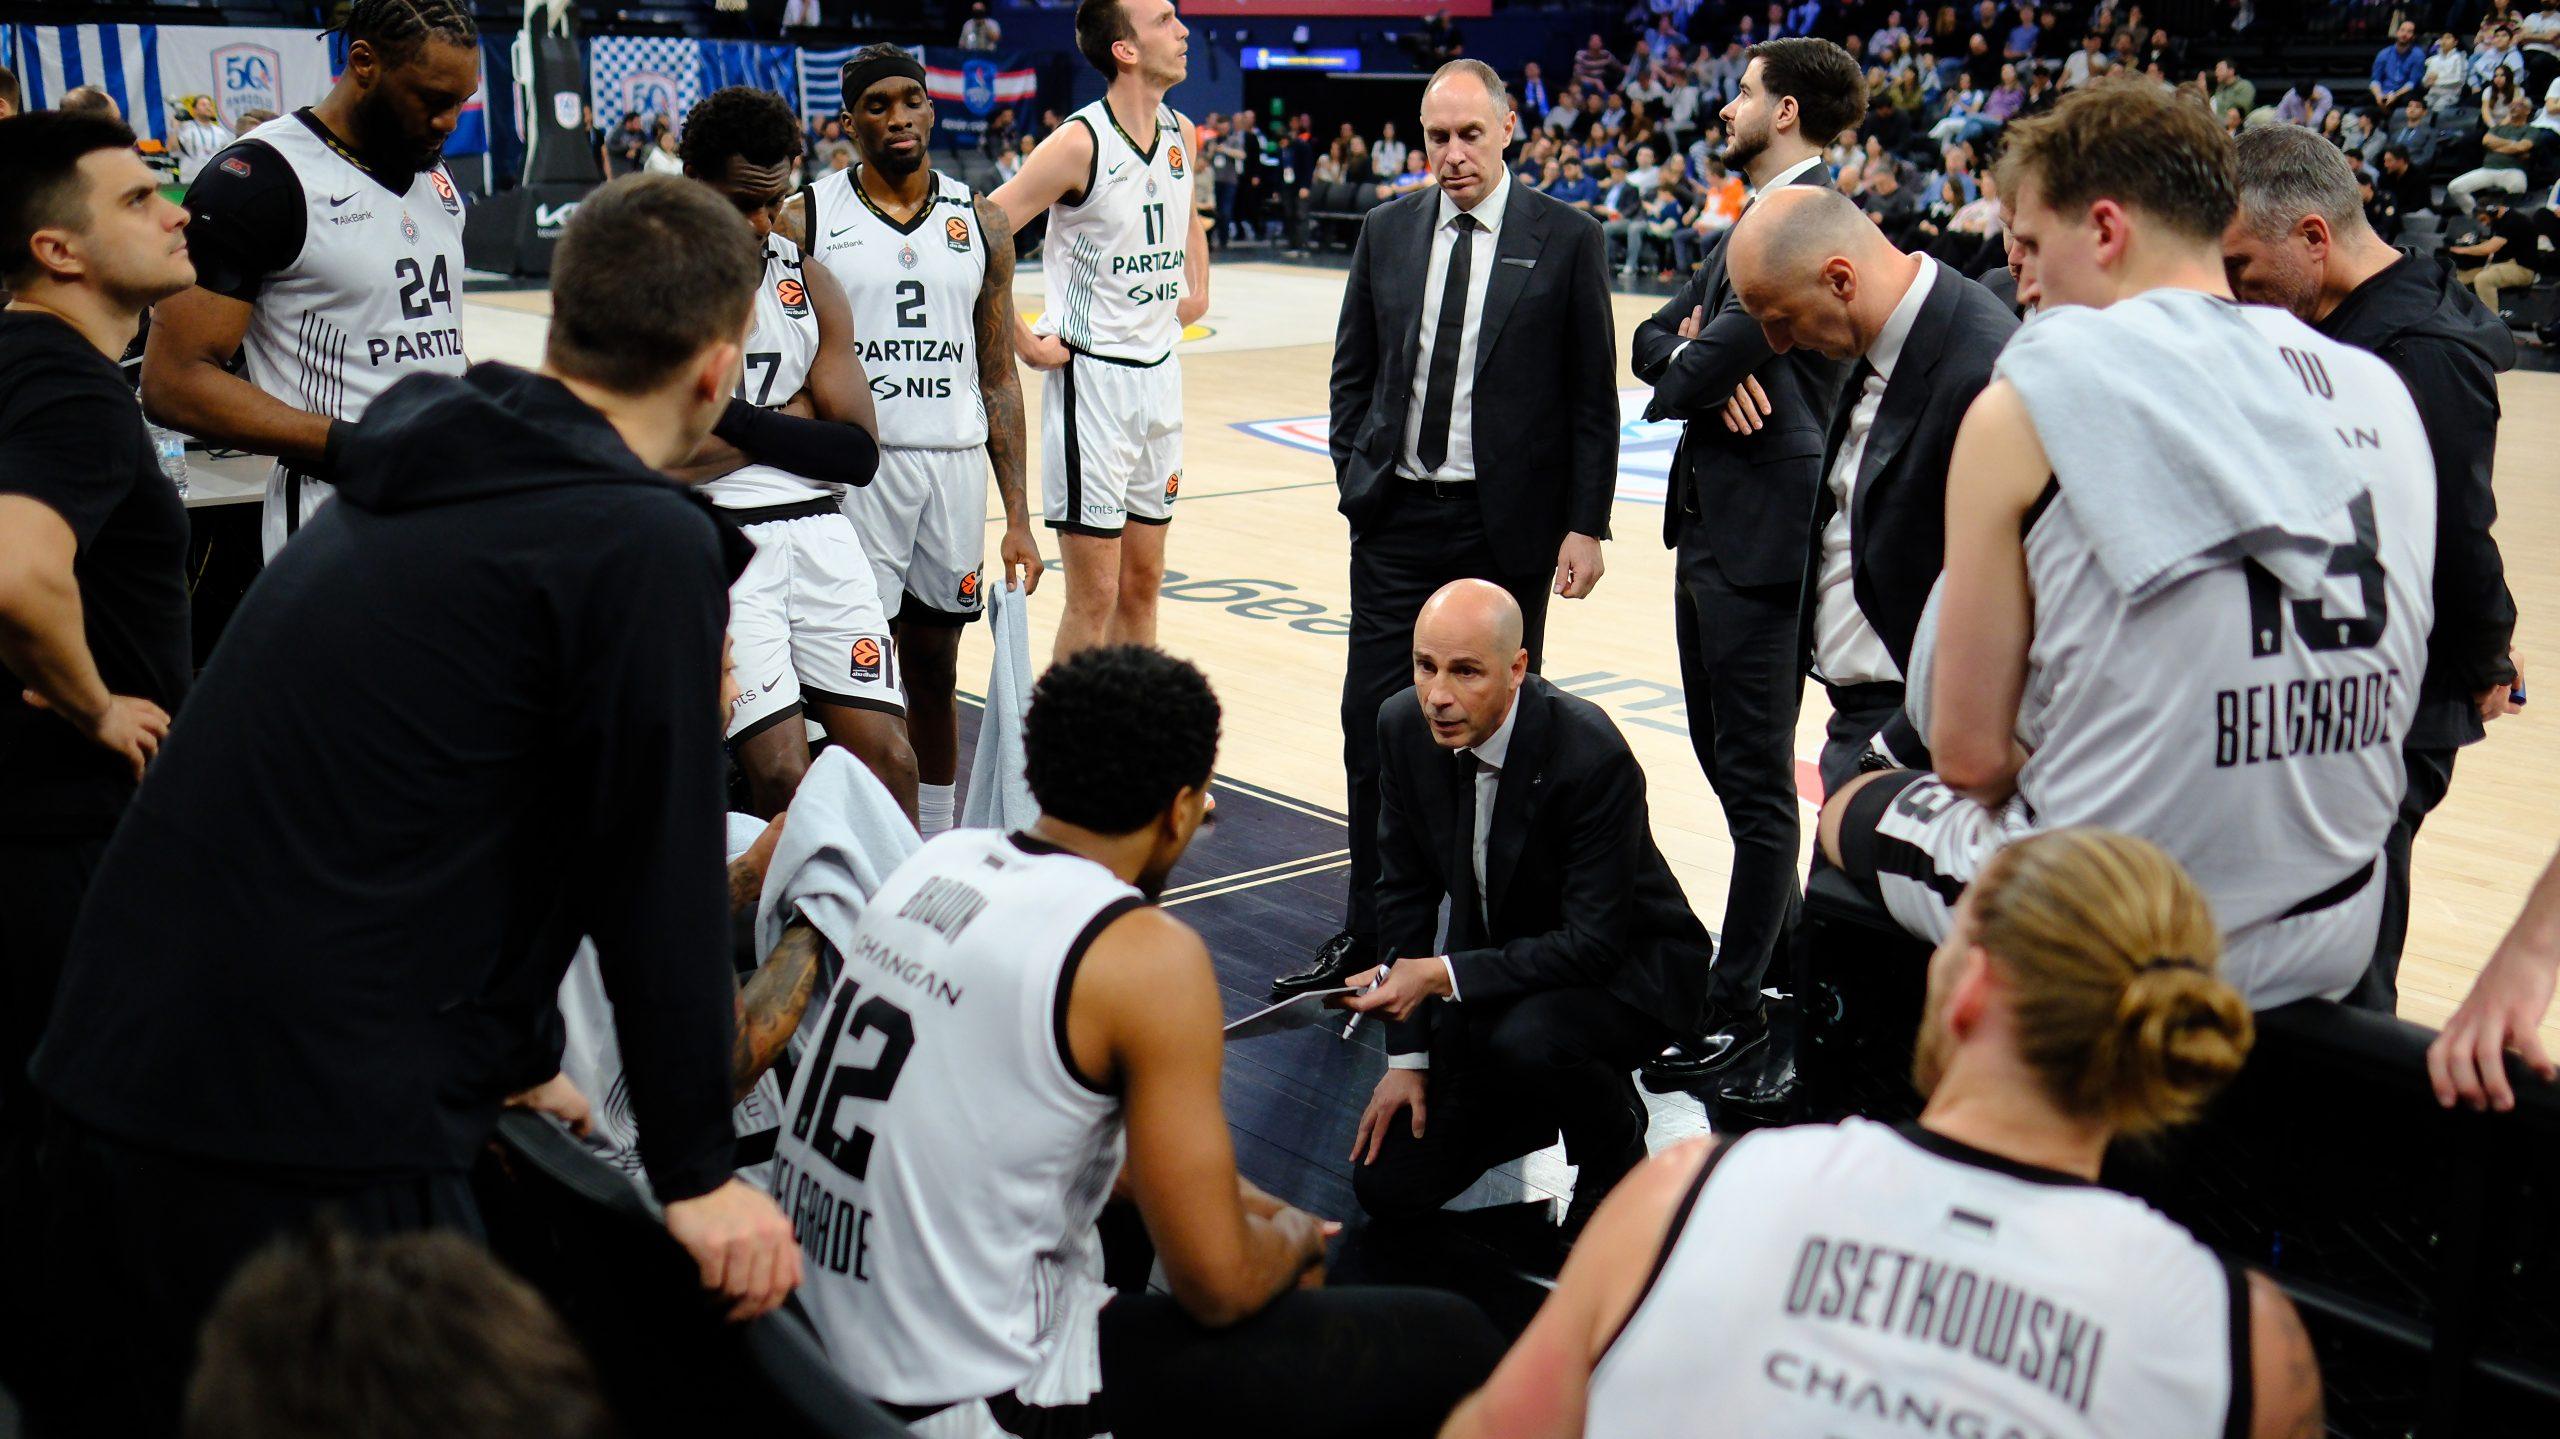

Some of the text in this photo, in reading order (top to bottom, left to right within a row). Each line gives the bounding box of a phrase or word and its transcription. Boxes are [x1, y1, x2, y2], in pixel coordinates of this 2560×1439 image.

[226, 56, 270, 91] 50
[339, 210, 375, 226] AikBank
[1143, 202, 1164, 246] 11
[831, 240, 864, 251] AikBank
[395, 254, 452, 320] 24
[896, 280, 927, 328] 2
[1156, 281, 1178, 301] NIS
[367, 328, 463, 367] PARTIZ
[906, 377, 952, 399] NIS
[1089, 503, 1114, 515] mts
[2243, 487, 2389, 660] 13
[2215, 668, 2400, 769] BELGRADE
[897, 876, 989, 944] BROWN
[792, 977, 916, 1182] 12
[1784, 1237, 2105, 1414] OSETKOWSKI
[1763, 1352, 2032, 1439] CHANG
